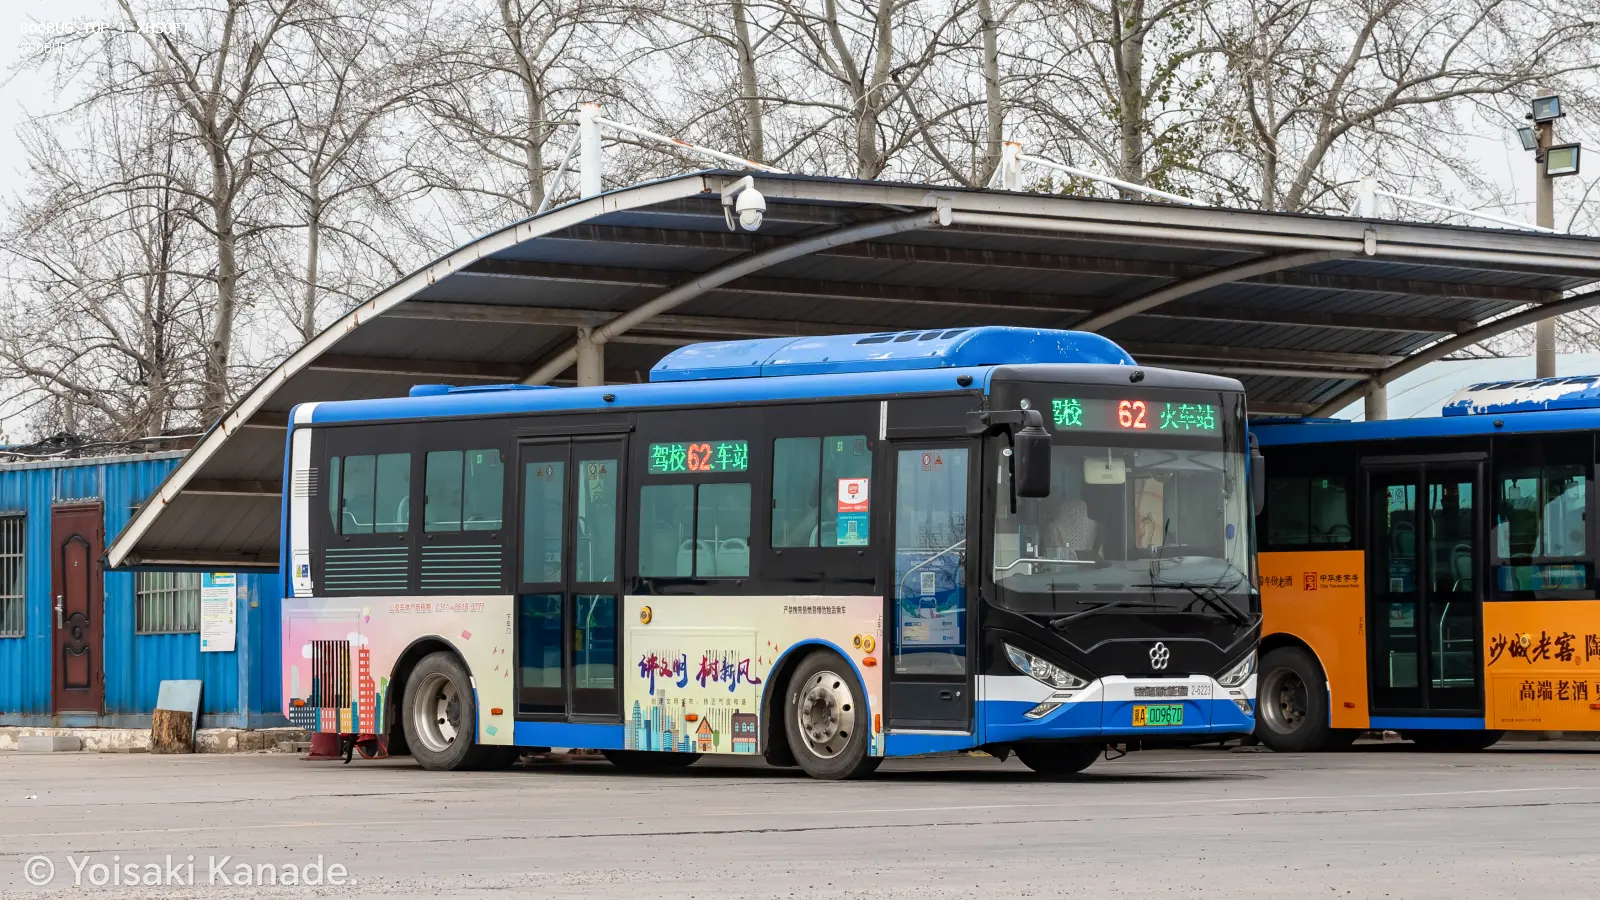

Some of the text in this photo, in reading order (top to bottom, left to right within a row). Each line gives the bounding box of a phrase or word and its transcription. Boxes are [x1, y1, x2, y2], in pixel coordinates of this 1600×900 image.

[1118, 400, 1147, 429] 62
[1160, 403, 1215, 430] 火车站
[651, 444, 687, 471] 驾校
[687, 443, 711, 471] 62
[1320, 574, 1359, 583] 中华老字号
[1487, 630, 1576, 667] 沙城老窖
[638, 653, 762, 696] 讲文明 树新风
[1191, 685, 1212, 696] 2-6223
[1519, 680, 1588, 701] 高端老酒
